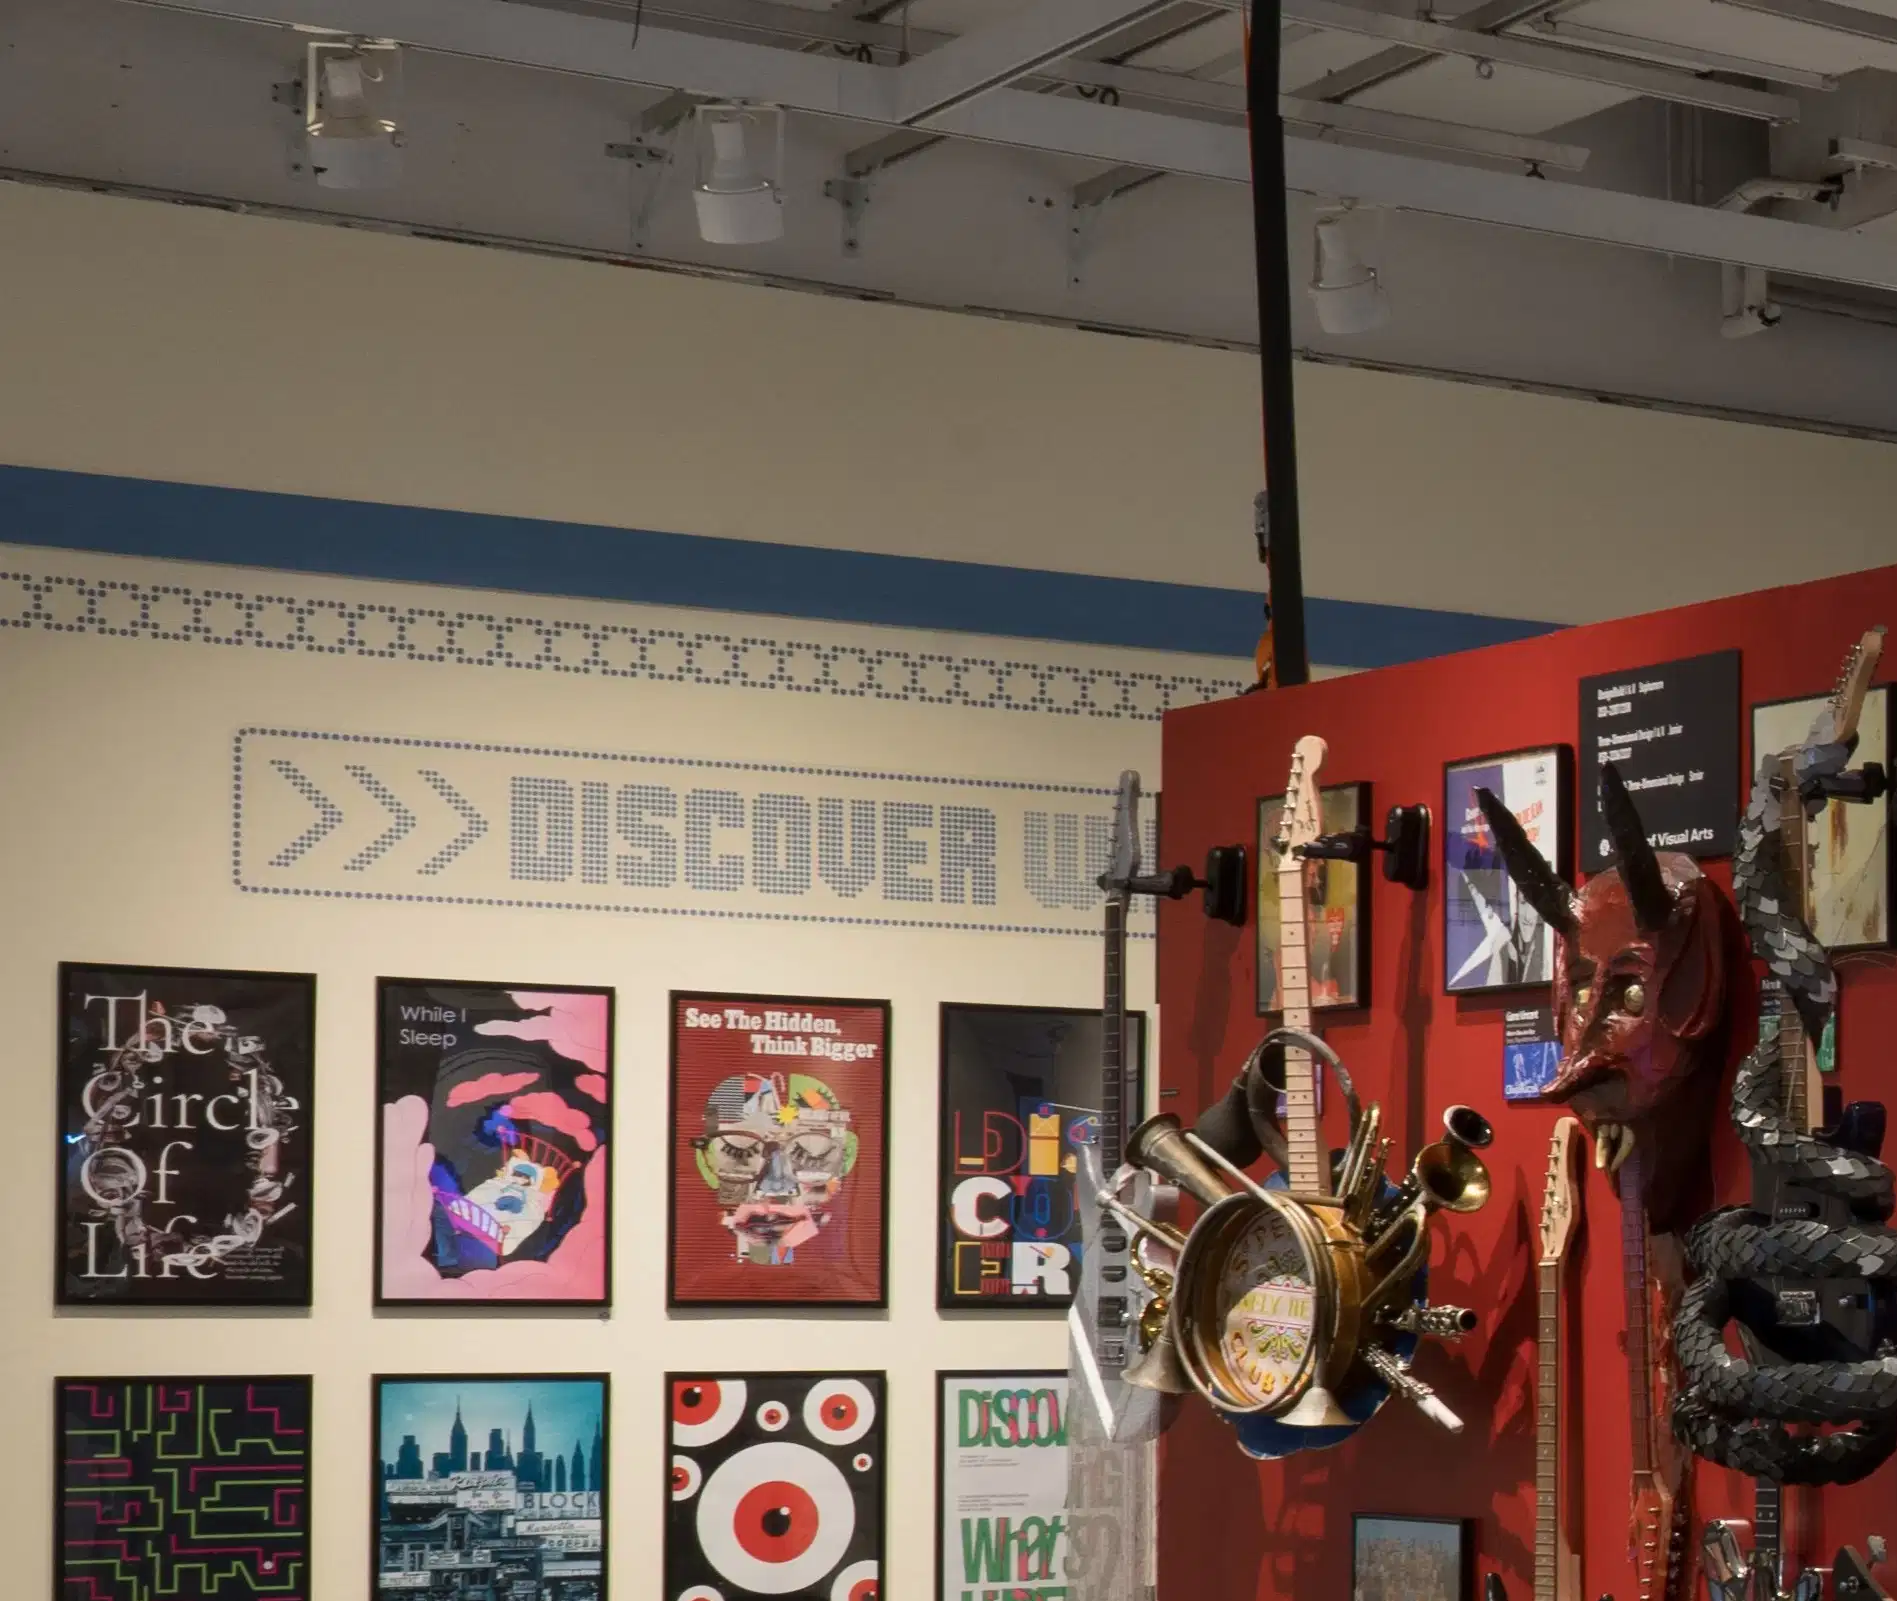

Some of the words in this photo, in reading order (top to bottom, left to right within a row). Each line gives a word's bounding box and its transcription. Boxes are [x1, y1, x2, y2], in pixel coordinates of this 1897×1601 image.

[510, 776, 997, 905] DISCOVER
[1658, 830, 1689, 846] Visual
[1690, 827, 1715, 842] Arts
[84, 989, 216, 1055] The
[400, 1005, 456, 1023] While
[461, 1009, 467, 1022] I
[685, 1008, 722, 1029] See
[724, 1009, 762, 1031] The
[764, 1011, 842, 1035] Hidden,
[400, 1028, 457, 1049] Sleep
[750, 1034, 808, 1056] Think
[810, 1036, 878, 1062] Bigger
[82, 1067, 300, 1131] Circle
[80, 1141, 194, 1206] Of
[80, 1214, 220, 1280] Life
